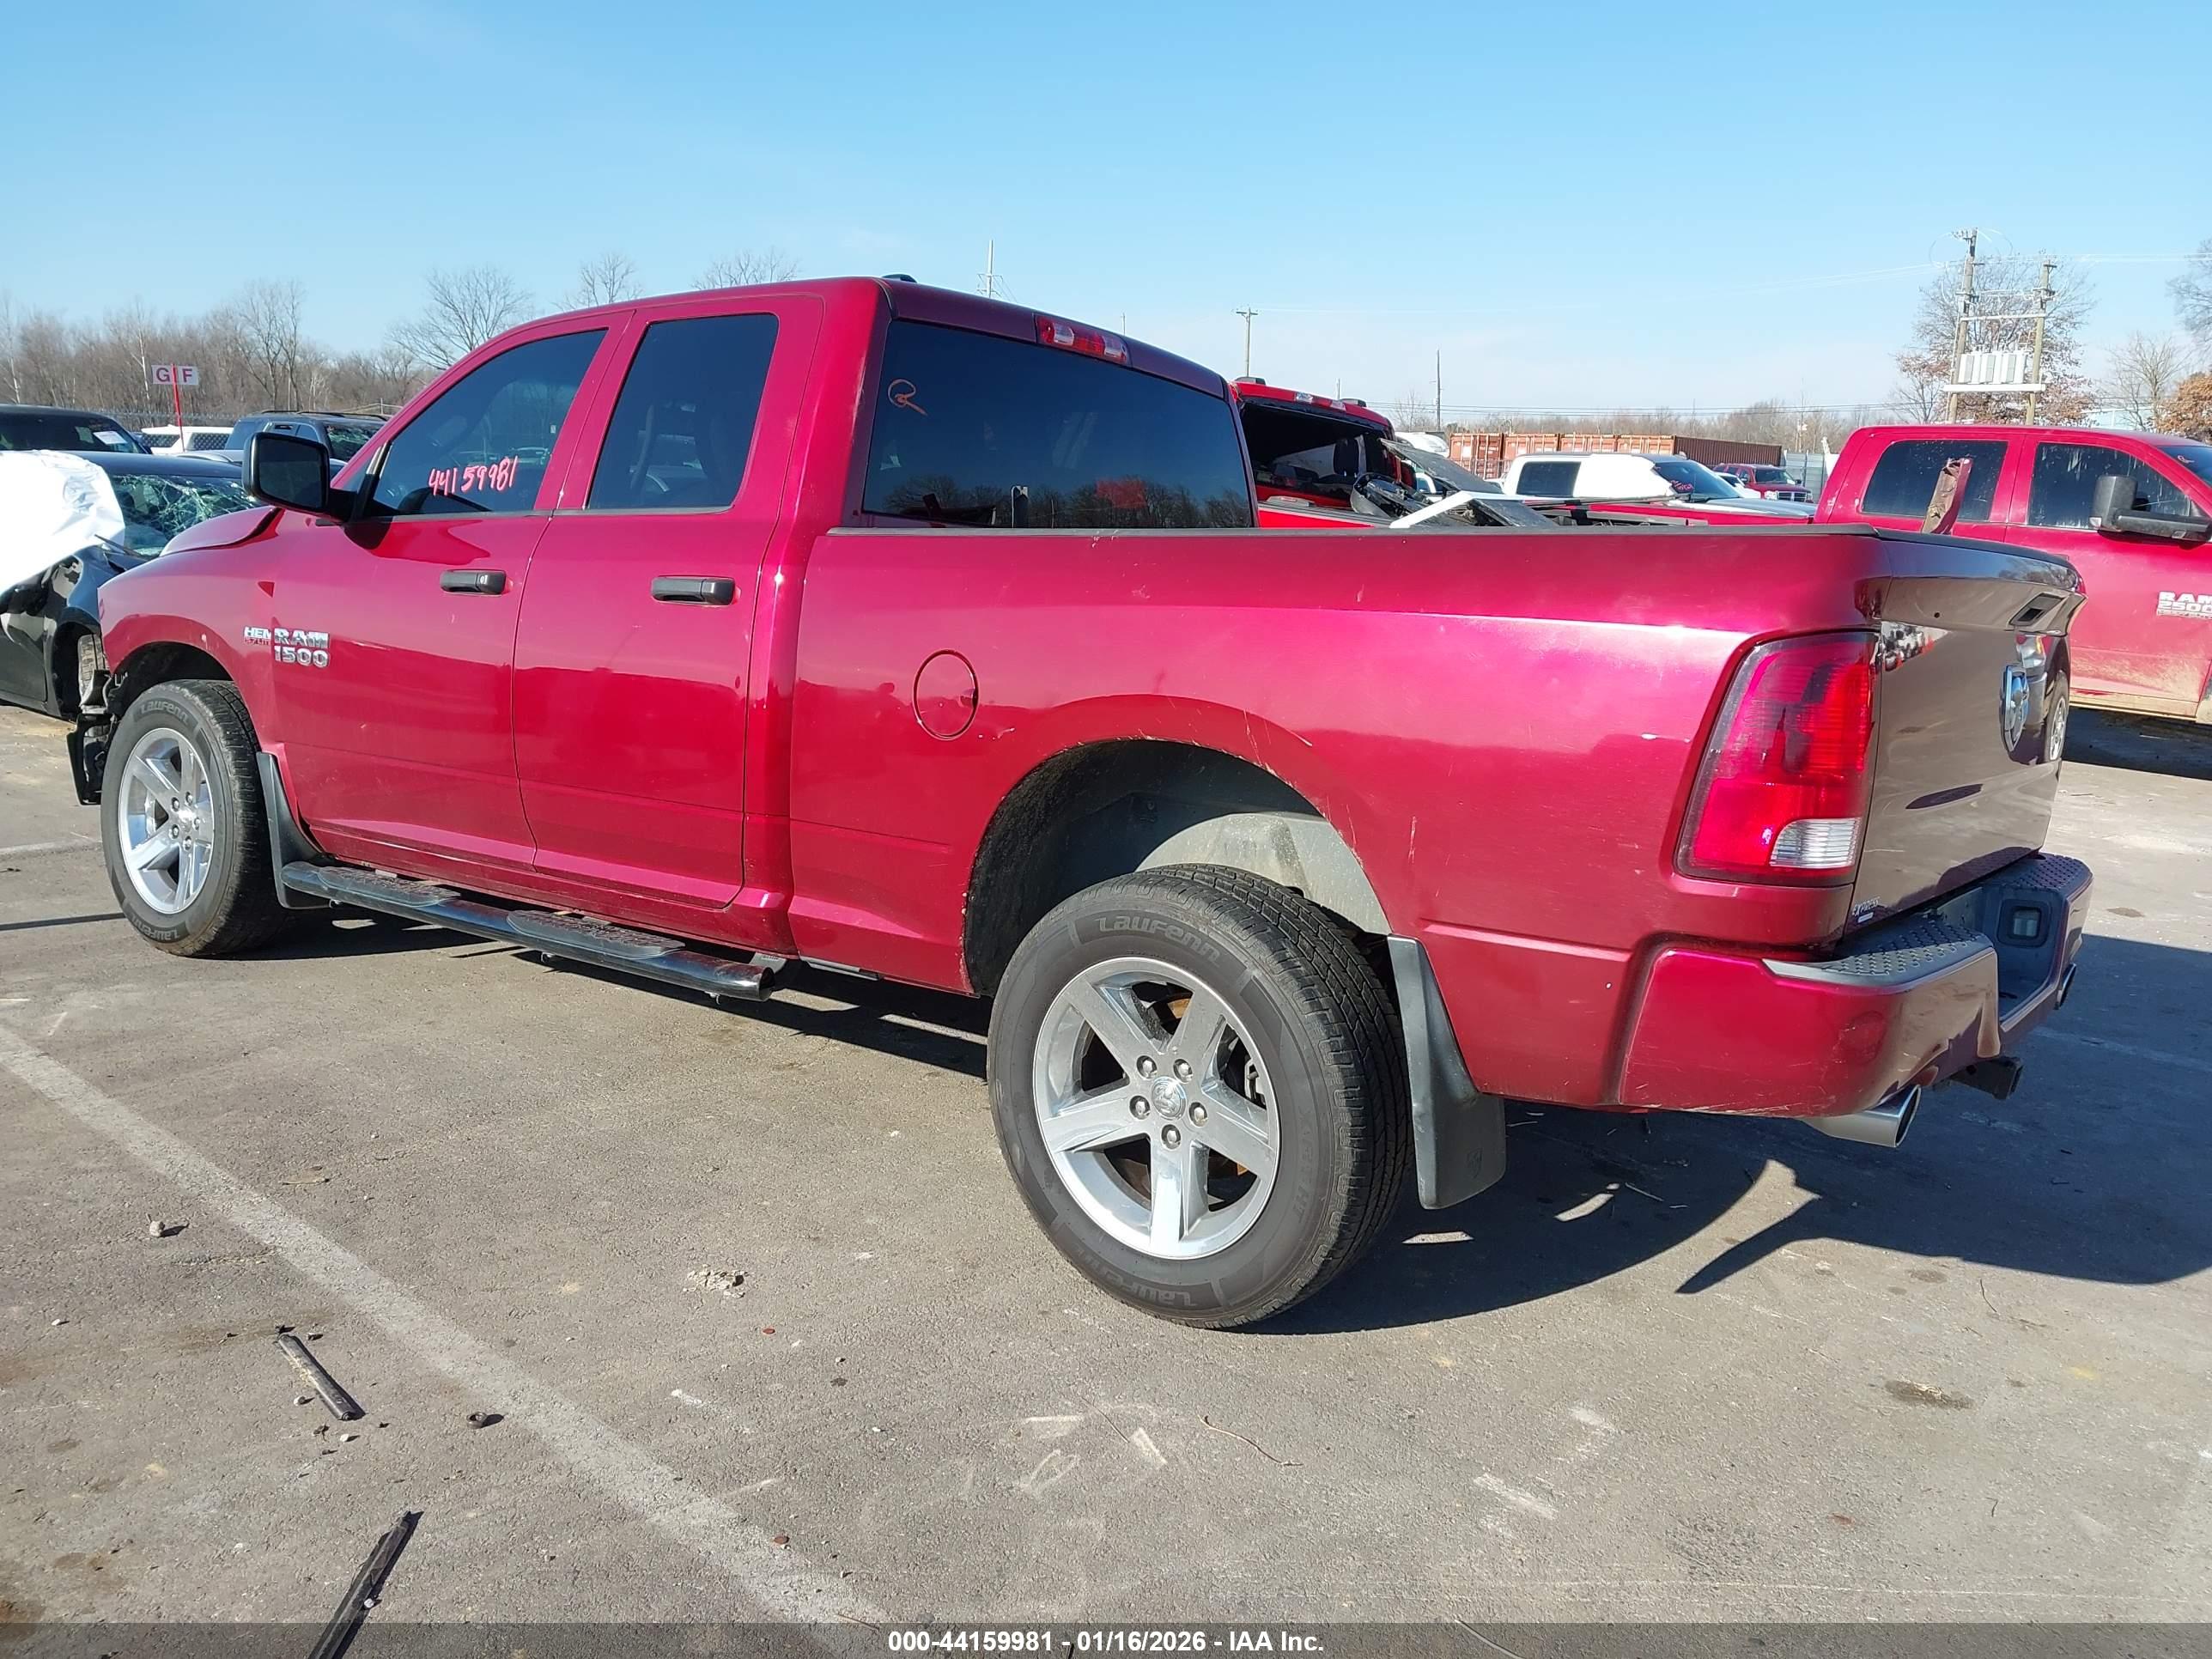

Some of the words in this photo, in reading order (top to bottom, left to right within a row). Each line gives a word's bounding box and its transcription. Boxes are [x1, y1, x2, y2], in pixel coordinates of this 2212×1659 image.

[156, 367, 171, 382] G
[182, 368, 192, 383] F
[274, 628, 330, 649] RAM
[274, 645, 330, 668] 1500
